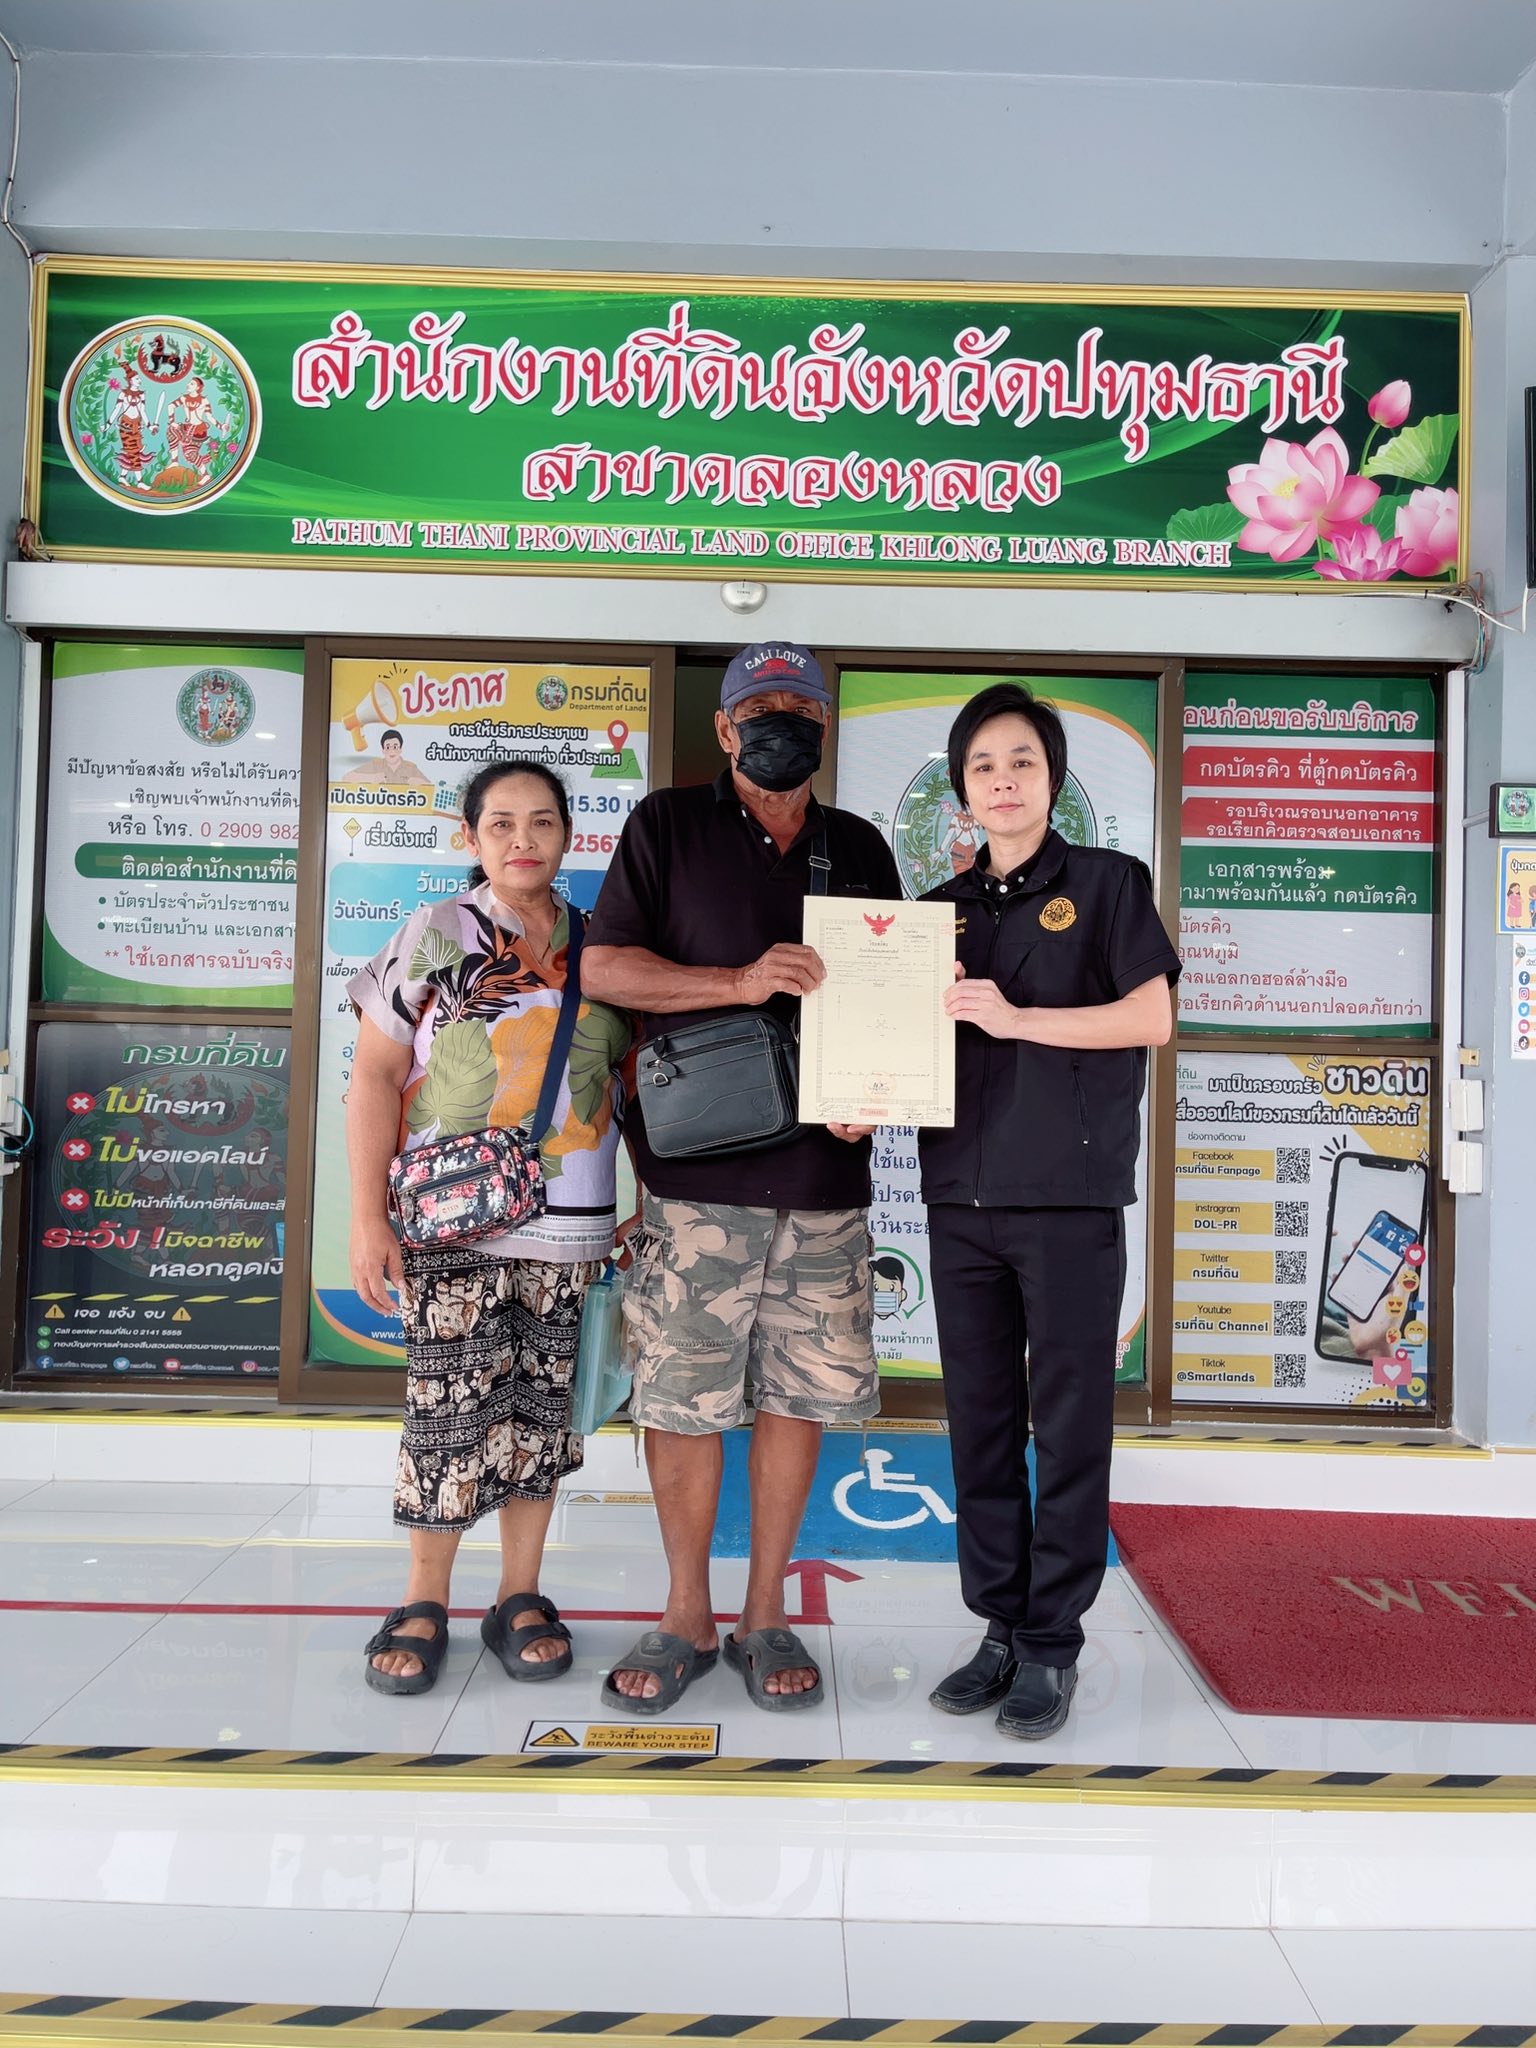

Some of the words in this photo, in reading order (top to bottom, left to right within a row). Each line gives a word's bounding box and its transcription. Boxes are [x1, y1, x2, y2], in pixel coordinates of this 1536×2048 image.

[291, 300, 1347, 463] สำนักงานที่ดินจังหวัดปทุมธานี
[521, 442, 1062, 514] สาขาคลองหลวง
[291, 517, 412, 548] PATHUM
[418, 521, 511, 551] THANI
[515, 525, 685, 555] PROVINCIAL
[691, 528, 769, 557] LAND
[776, 531, 875, 560] OFFICE
[880, 533, 1002, 562] KHLONG
[1008, 536, 1107, 565] LUANG
[1113, 538, 1231, 567] BRANCH
[745, 648, 773, 670] CALI
[775, 649, 807, 669] LOVE
[402, 671, 506, 716] ประกาศ
[570, 676, 647, 703] กรมที่ดิน
[569, 703, 614, 712] Department
[625, 704, 647, 712] Lands
[1184, 698, 1419, 734] อนก่อนขอรับบริการ
[449, 719, 588, 741] การให้บริการประชาชน
[559, 742, 621, 766] ทั่วประเทศ
[67, 757, 186, 779] มีปัญหาข้อสงสัย
[1200, 756, 1291, 779] กดบัตรคิว
[1298, 753, 1418, 786] ที่ตู้กดบัตรคิว
[330, 787, 427, 807] เปิดรับบัตรคิว
[1226, 801, 1419, 822] รอบริเวณรอบนอกอาคาร
[108, 814, 146, 836] หรือ
[153, 814, 193, 837] โทร.
[200, 821, 212, 838] 0
[218, 822, 263, 839] 2909
[365, 820, 437, 848] เริ่มตั้งแต่
[1206, 820, 1422, 841] รอเรียกคิวตรวจสอบเอกสาร
[1208, 858, 1332, 880] เอกสารพร้อม
[113, 889, 289, 912] บัตรประจำตัวประชาชน
[1180, 881, 1327, 903] ามาพร้อมกันแล้ว
[1334, 885, 1417, 905] กดบัตรคิว
[333, 899, 401, 921] วันจันทร์
[113, 917, 208, 936] ทะเบียนบ้าน
[214, 922, 296, 938] และเอกสา
[125, 945, 292, 970] ใช้เอกสารฉบับจริง
[122, 1031, 287, 1068] กรมที่ดิน
[1208, 1073, 1323, 1095] มาเป็นครอบครัว
[1325, 1059, 1429, 1097] ชาวดิน
[105, 1086, 227, 1116] ไม่โทรหา
[1188, 1131, 1246, 1142] ช่องทางติดตาม
[99, 1136, 269, 1166] ไม่ขอแอดไลน์
[1192, 1151, 1234, 1161] Facebook
[1217, 1165, 1261, 1177] Fanpage
[871, 1180, 922, 1203] โปรด
[1194, 1219, 1238, 1230] DOL-PR
[1200, 1253, 1229, 1263] Twitter
[1192, 1265, 1239, 1279] กรมที่ดิน
[74, 1309, 101, 1318] เจอ
[108, 1306, 136, 1319] แจ้ง
[144, 1310, 166, 1319] จบ
[1197, 1304, 1232, 1315] Youtube
[54, 1327, 70, 1335] Call
[872, 1330, 933, 1345] วมหน้ากาก
[1218, 1321, 1268, 1332] Channel
[1200, 1358, 1226, 1368] Tiktok
[1176, 1371, 1255, 1382] @Smartlands
[587, 1740, 639, 1748] BEWARE
[590, 1727, 710, 1741] ระวังพื้นต่างระดับ
